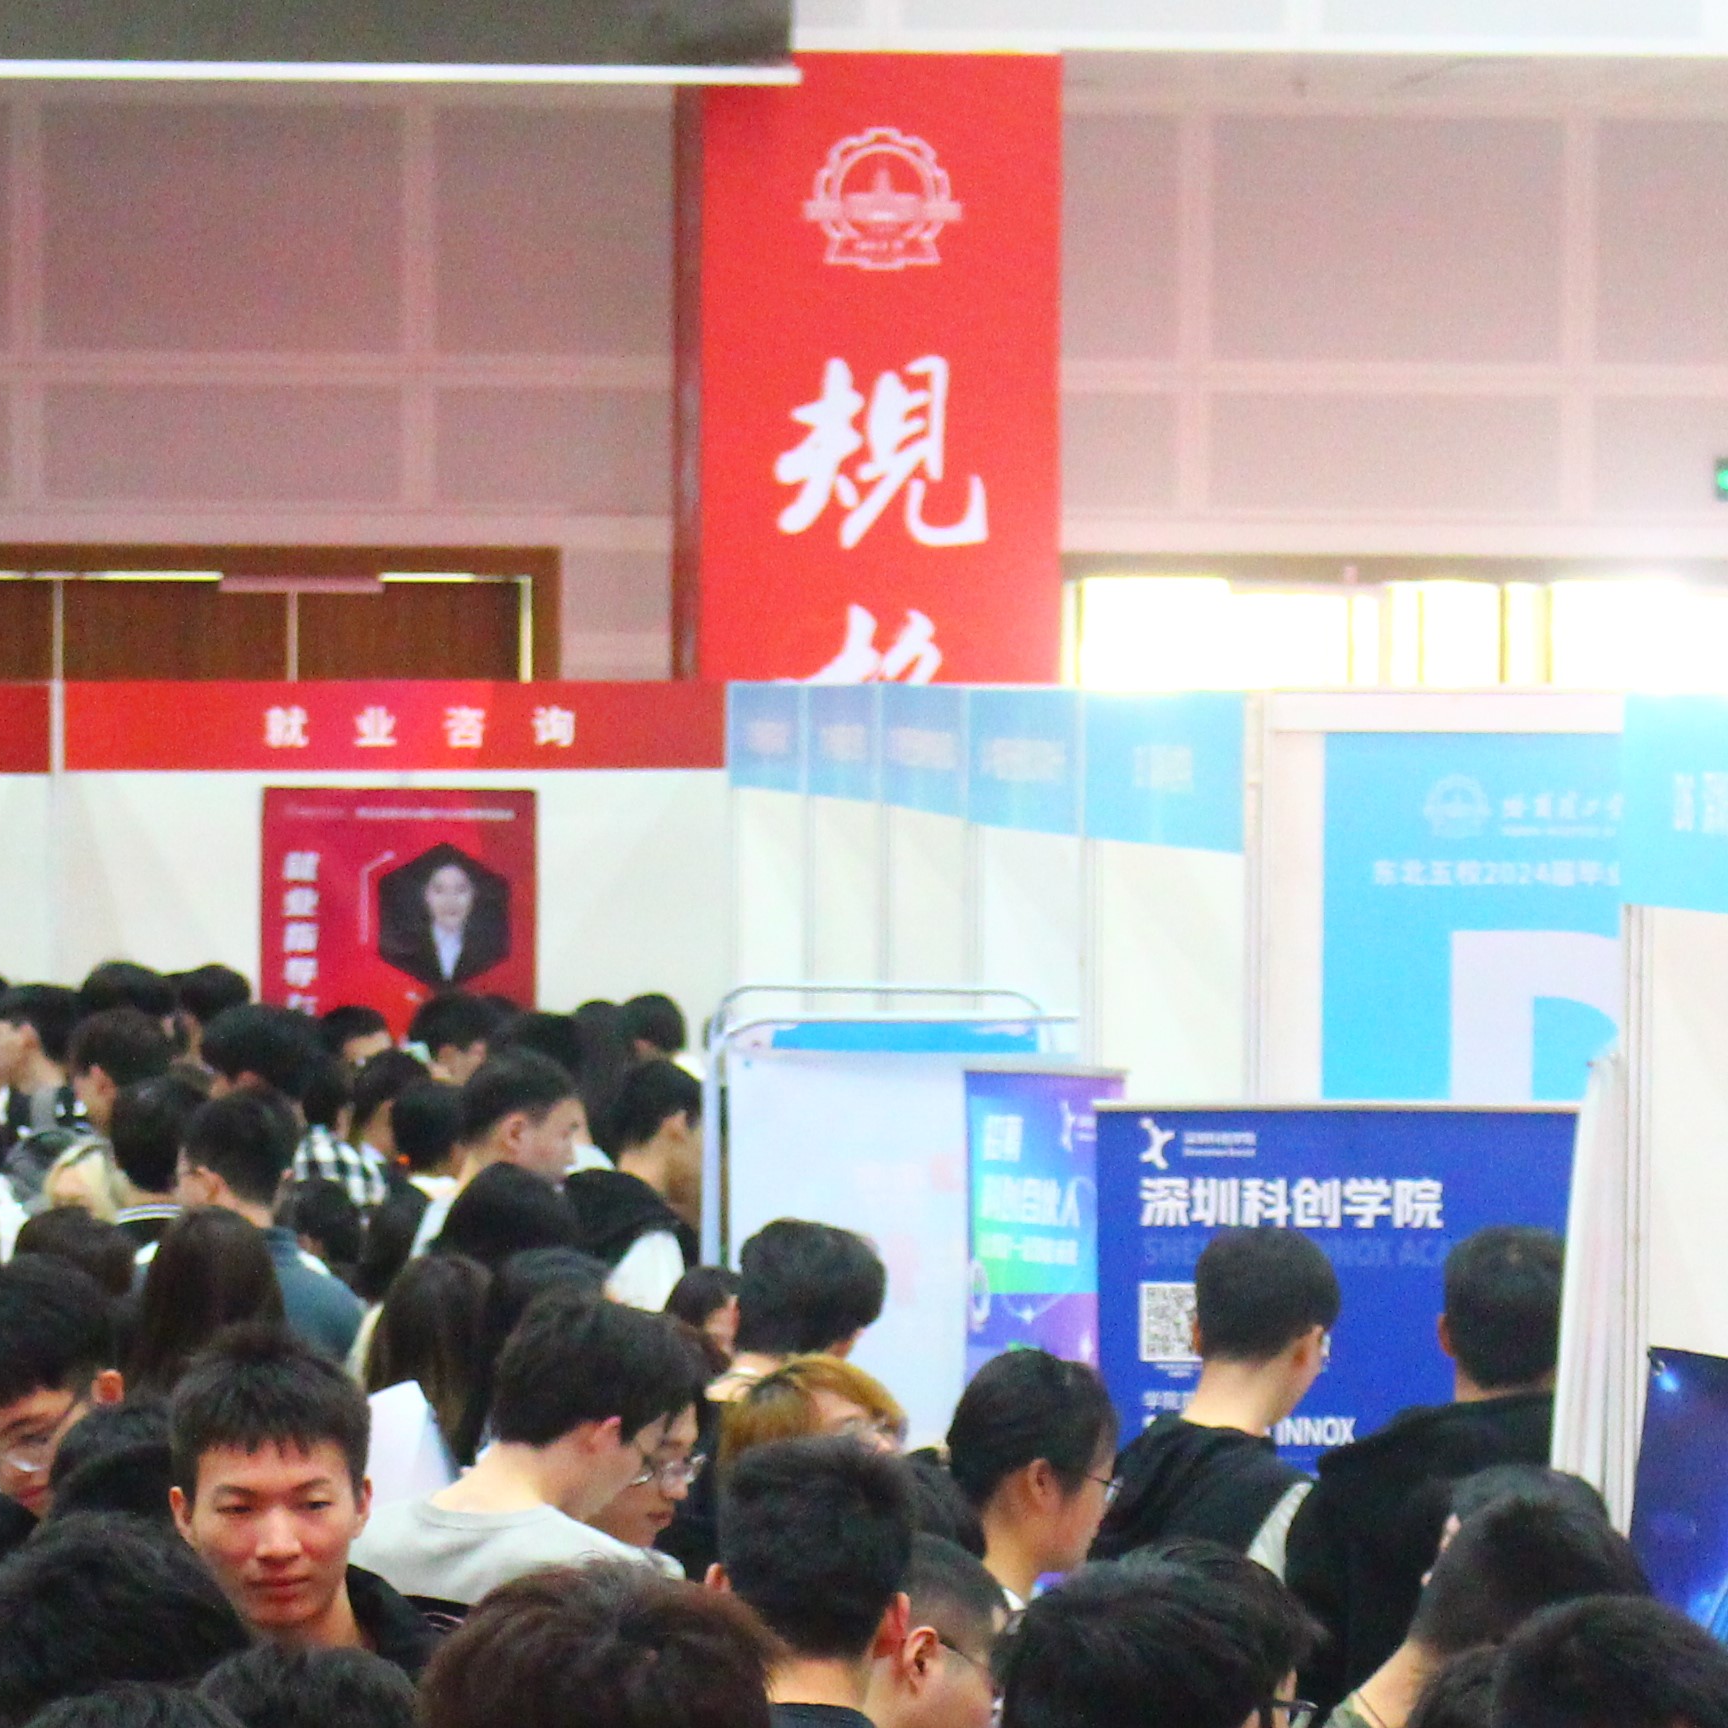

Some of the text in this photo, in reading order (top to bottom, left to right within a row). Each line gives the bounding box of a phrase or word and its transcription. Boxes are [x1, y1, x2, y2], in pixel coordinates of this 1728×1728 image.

[263, 705, 576, 749] 就业咨询
[1139, 1177, 1445, 1229] 深圳科创学院
[1275, 1416, 1356, 1446] INNOX
